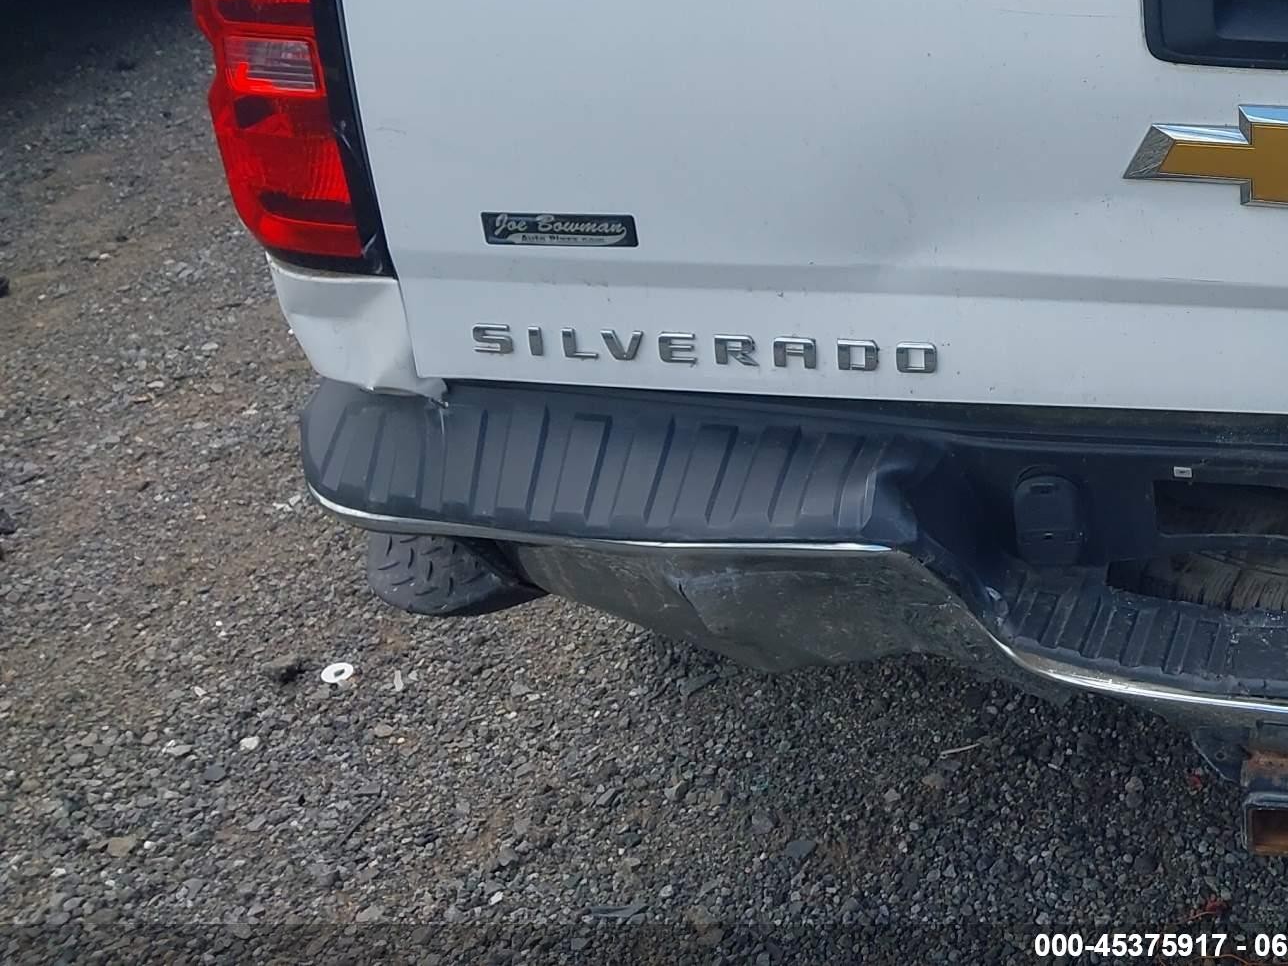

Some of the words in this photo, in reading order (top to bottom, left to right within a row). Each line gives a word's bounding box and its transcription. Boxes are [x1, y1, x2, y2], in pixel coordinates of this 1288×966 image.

[494, 213, 528, 236] Joe
[536, 214, 627, 236] Bowman
[472, 322, 938, 374] SILVERADO
